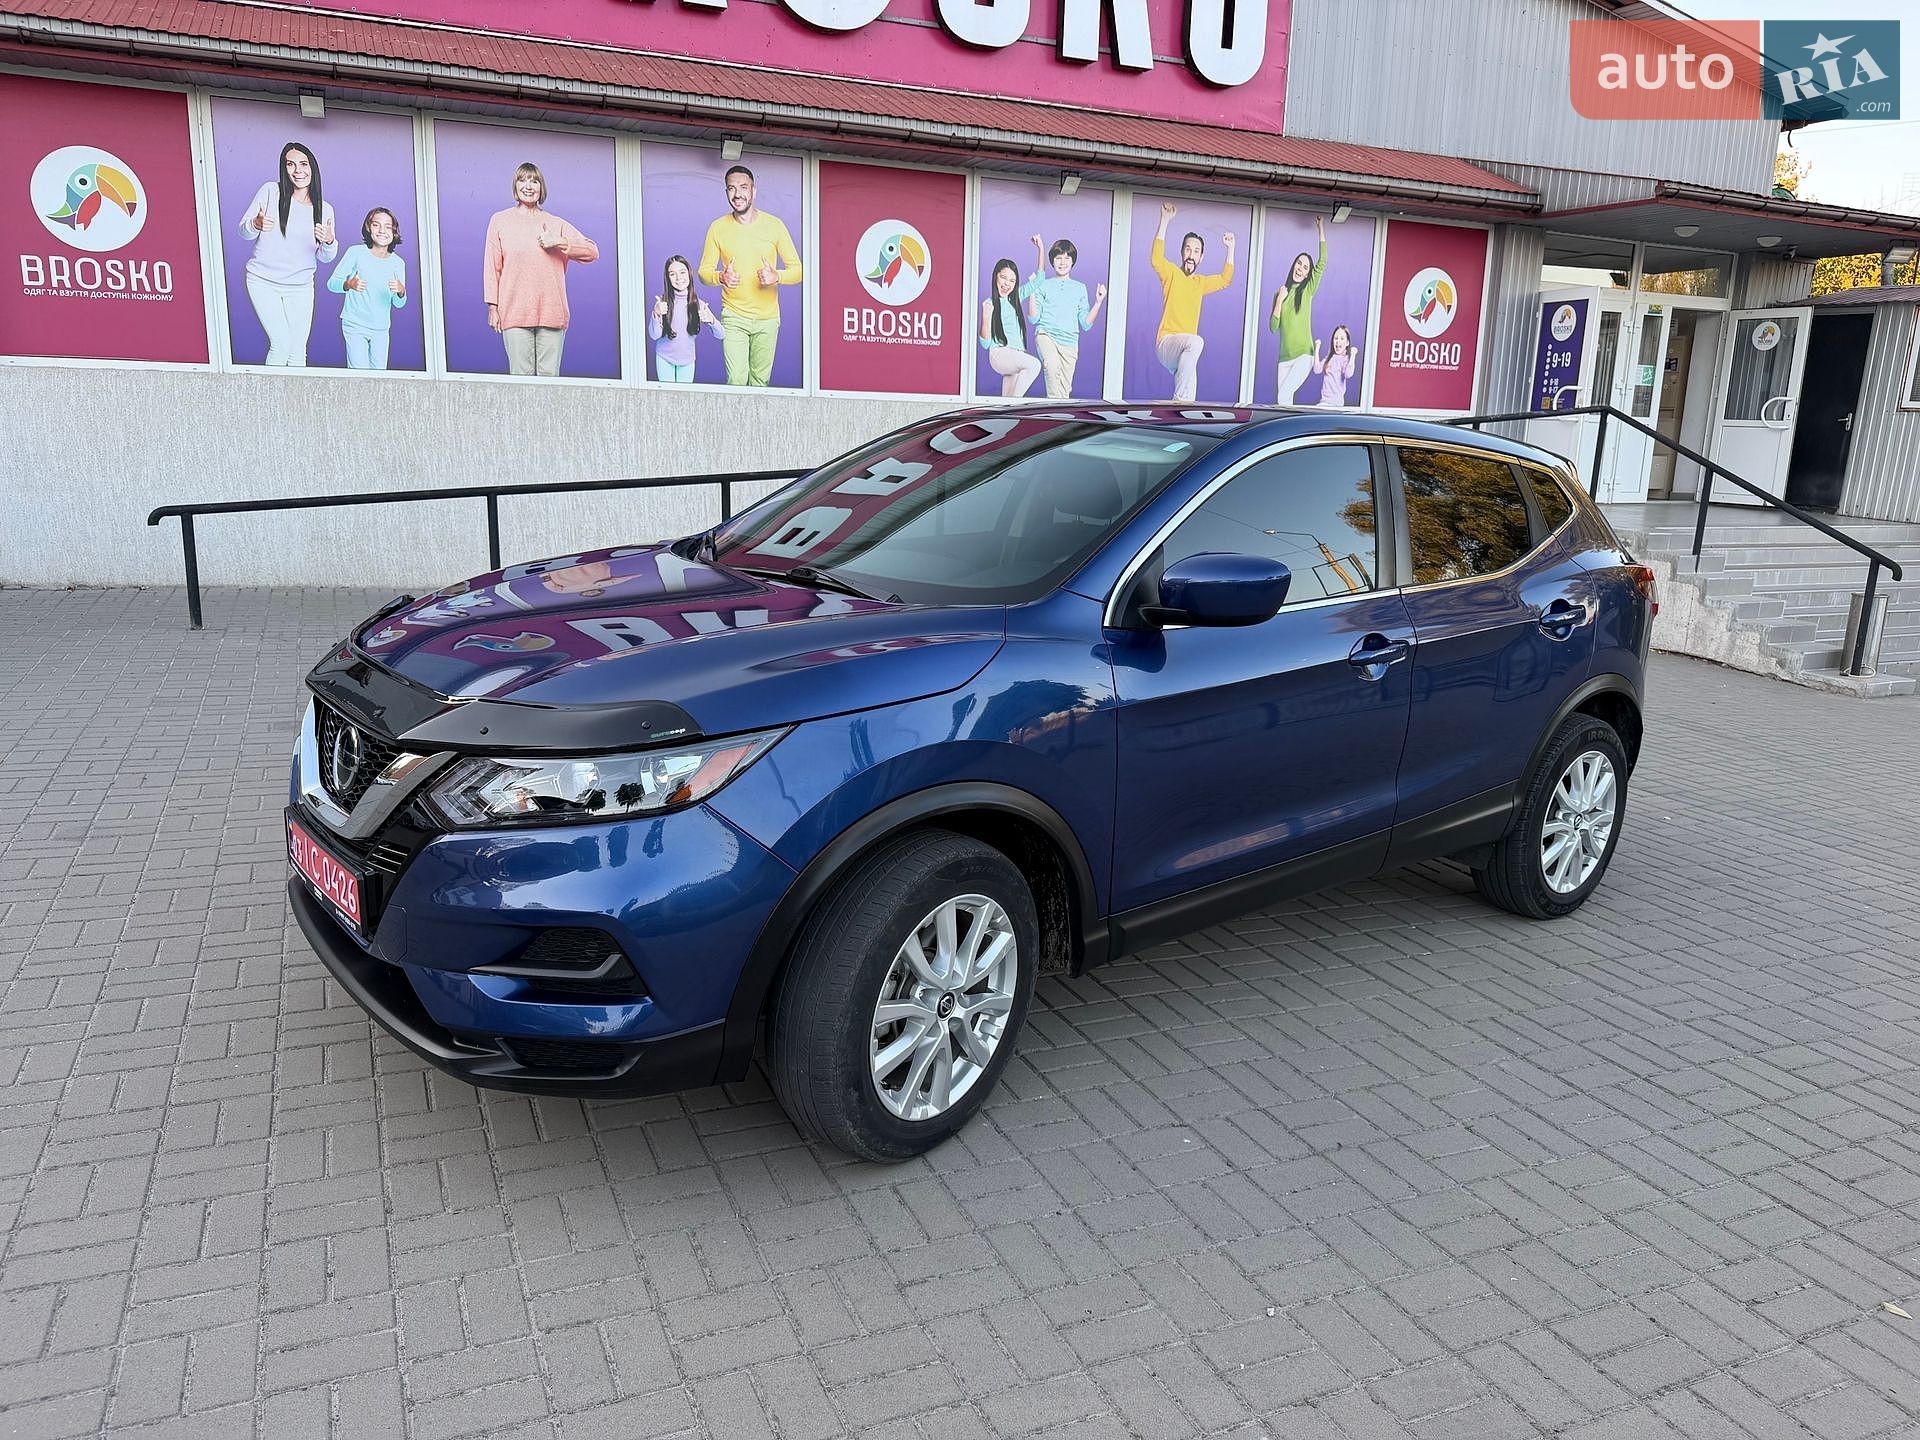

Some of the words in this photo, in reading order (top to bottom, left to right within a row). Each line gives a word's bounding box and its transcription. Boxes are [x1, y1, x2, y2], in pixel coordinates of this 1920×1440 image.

[20, 254, 173, 293] BROSKO
[23, 287, 45, 296] ОДЯГ
[60, 290, 89, 298] ВЗУТТЯ
[90, 291, 130, 300] ДОСТУПНІ
[131, 293, 173, 302] КОЖНОМУ
[843, 307, 942, 340] BROSKO
[1390, 339, 1461, 366] BROSKO
[1551, 351, 1571, 368] 9-19
[322, 856, 357, 914] 0426
